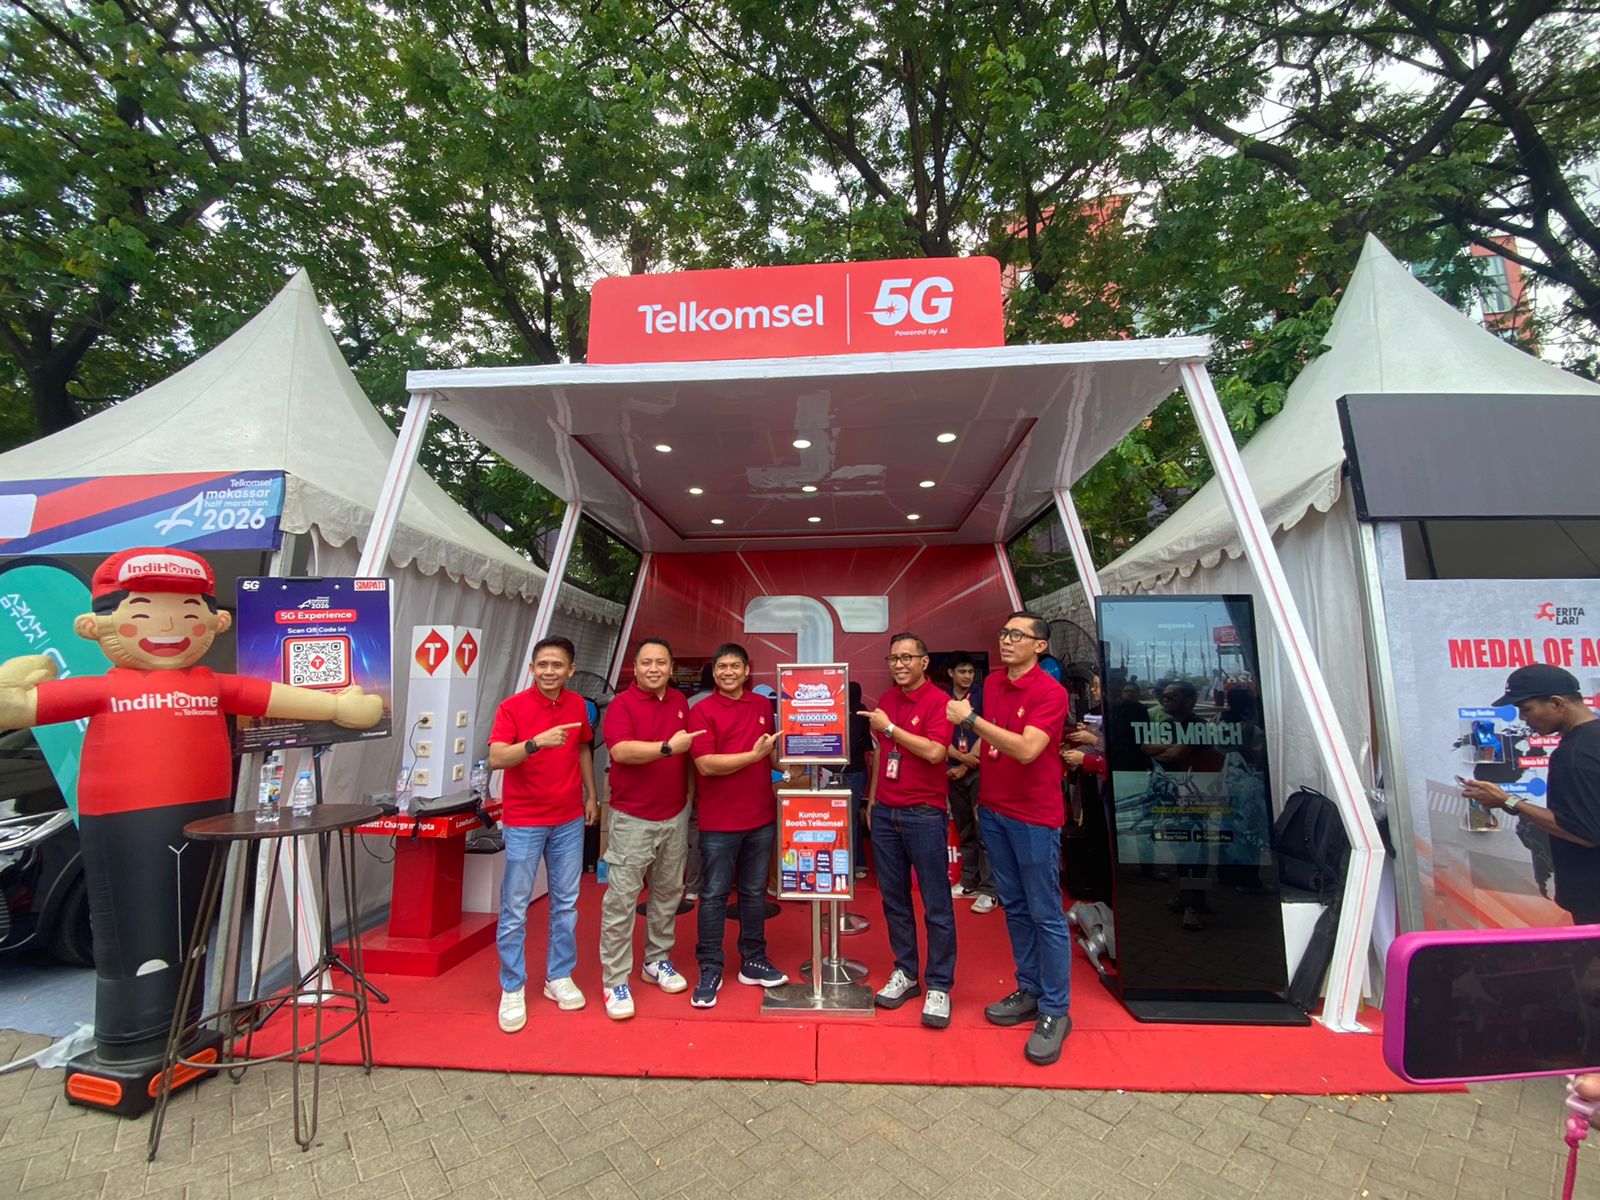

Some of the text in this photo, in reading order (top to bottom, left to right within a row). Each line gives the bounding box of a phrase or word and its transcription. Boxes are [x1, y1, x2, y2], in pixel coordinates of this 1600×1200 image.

[865, 276, 954, 326] 5G
[637, 294, 824, 334] Telkomsel
[230, 478, 272, 487] Telkomsel
[206, 488, 271, 499] makassar
[204, 499, 269, 507] half marathon
[201, 508, 266, 530] 2026
[128, 562, 201, 575] IndiHome
[242, 581, 260, 590] 5G
[354, 581, 385, 590] SIMPATI
[281, 611, 352, 621] 5G Experience
[1556, 616, 1579, 625] LARI
[1448, 639, 1538, 668] MEDAL
[1543, 638, 1574, 667] OF
[111, 691, 218, 712] IndiHome
[182, 708, 218, 716] Telkomsel
[1131, 722, 1243, 745] THIS MARCH
[799, 811, 830, 820] Kunjungi
[785, 819, 844, 827] Booth Telkomsel
